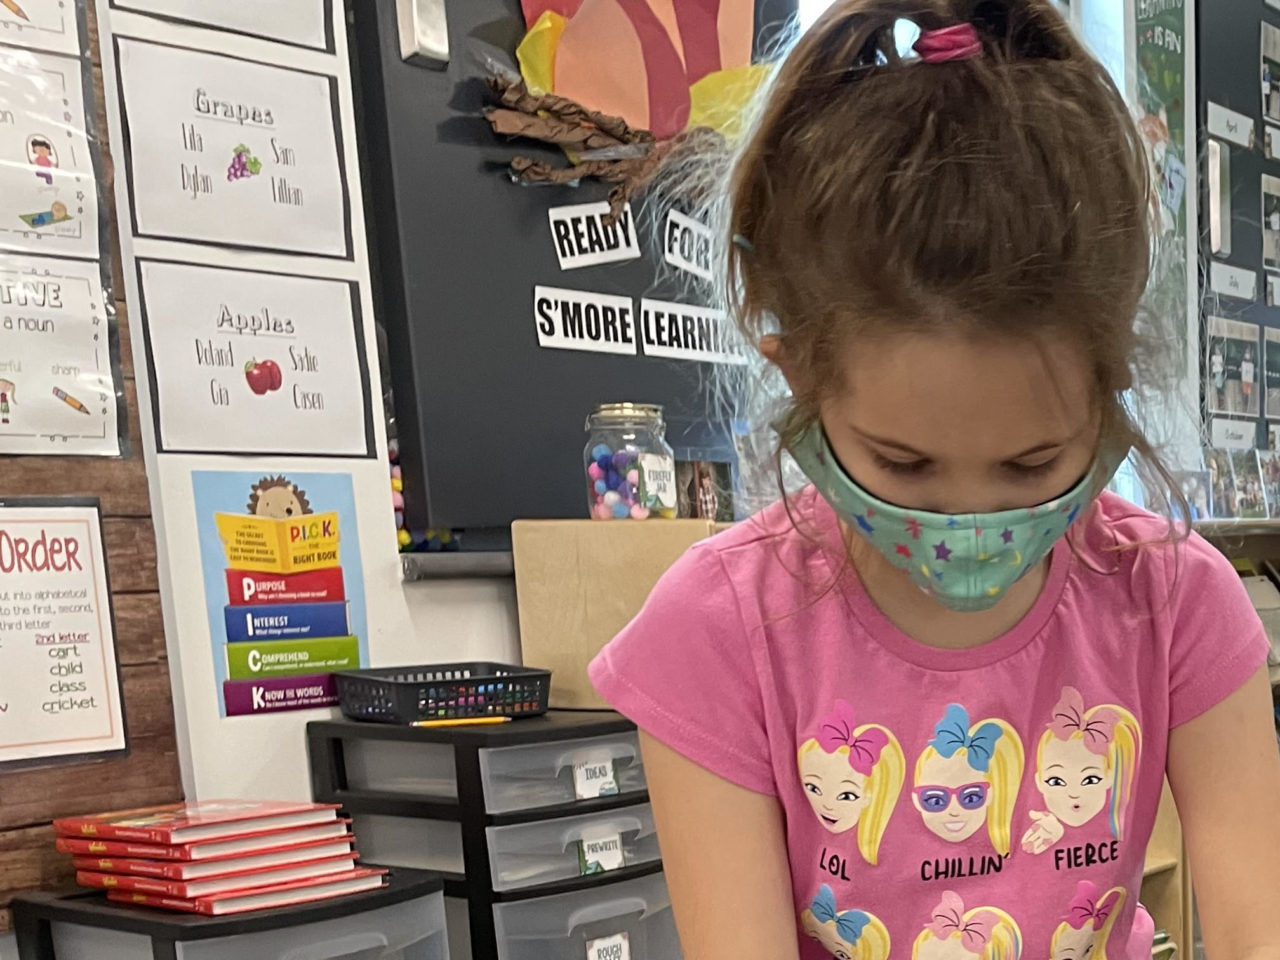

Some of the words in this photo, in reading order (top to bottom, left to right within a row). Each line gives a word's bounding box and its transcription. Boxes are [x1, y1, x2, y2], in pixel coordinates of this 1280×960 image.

[194, 88, 275, 126] Grapes
[270, 137, 296, 167] Sam
[180, 163, 213, 199] Dylan
[552, 210, 633, 259] READY
[667, 220, 711, 272] FOR
[4, 316, 13, 331] a
[17, 317, 55, 333] noun
[217, 303, 296, 336] Apples
[537, 297, 634, 344] S'MORE
[195, 338, 235, 368] Roland
[288, 344, 319, 374] Sadie
[210, 378, 230, 407] Gia
[292, 383, 325, 411] Casen
[317, 550, 338, 563] BOOK
[242, 577, 287, 601] PURPOSE
[58, 631, 90, 642] letter
[246, 612, 289, 636] INTEREST
[48, 645, 80, 659] cart
[247, 649, 310, 672] COMPREHEND
[49, 661, 84, 677] child
[49, 680, 87, 696] class
[42, 696, 97, 714] cricket
[585, 765, 608, 781] IDEAS
[819, 846, 851, 882] LOL
[920, 852, 1010, 882] CHILLIN'
[1054, 840, 1120, 871] FIERCE
[597, 943, 622, 960] ROUGH
